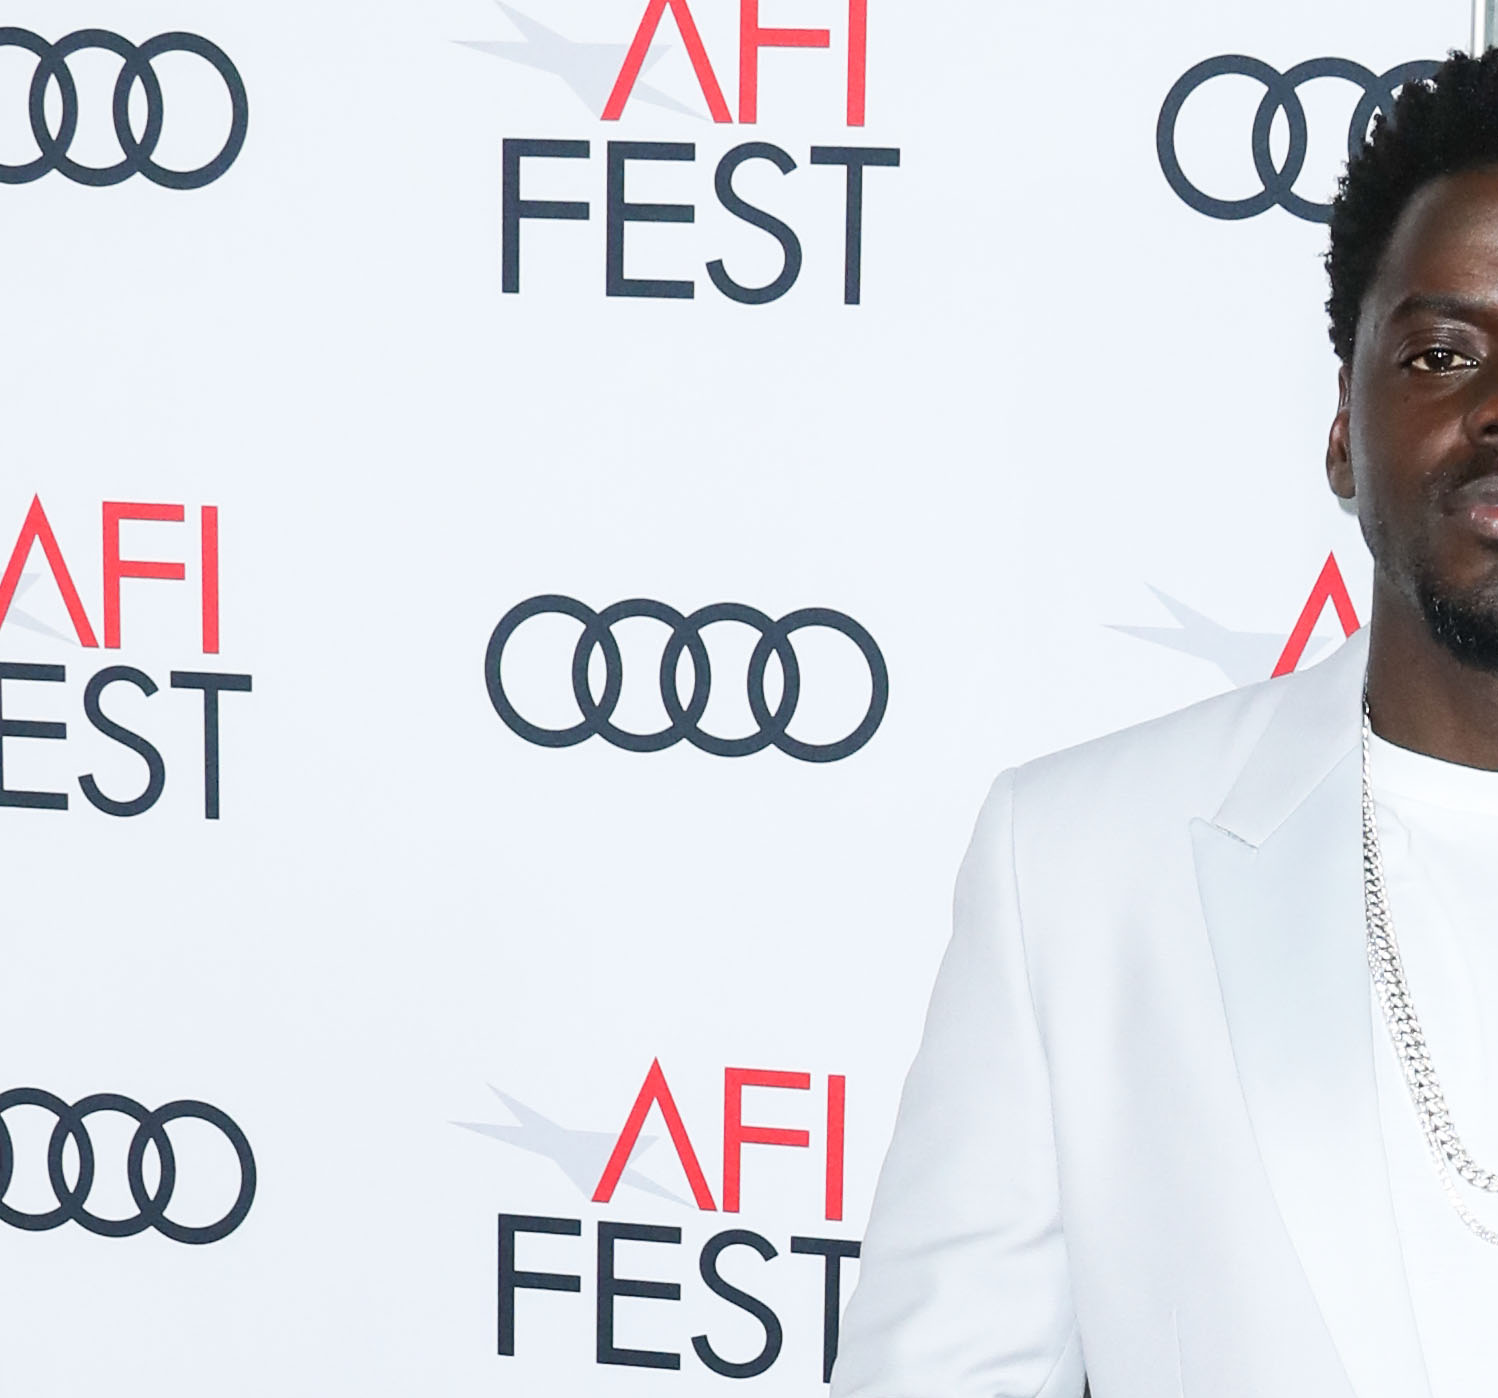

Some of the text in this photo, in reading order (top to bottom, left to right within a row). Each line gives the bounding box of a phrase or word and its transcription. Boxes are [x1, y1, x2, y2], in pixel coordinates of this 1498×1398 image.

[602, 0, 866, 126] AFI
[503, 139, 900, 304] FEST
[0, 495, 218, 653] AFI
[592, 1058, 845, 1220] AFI
[498, 1214, 861, 1384] FEST
